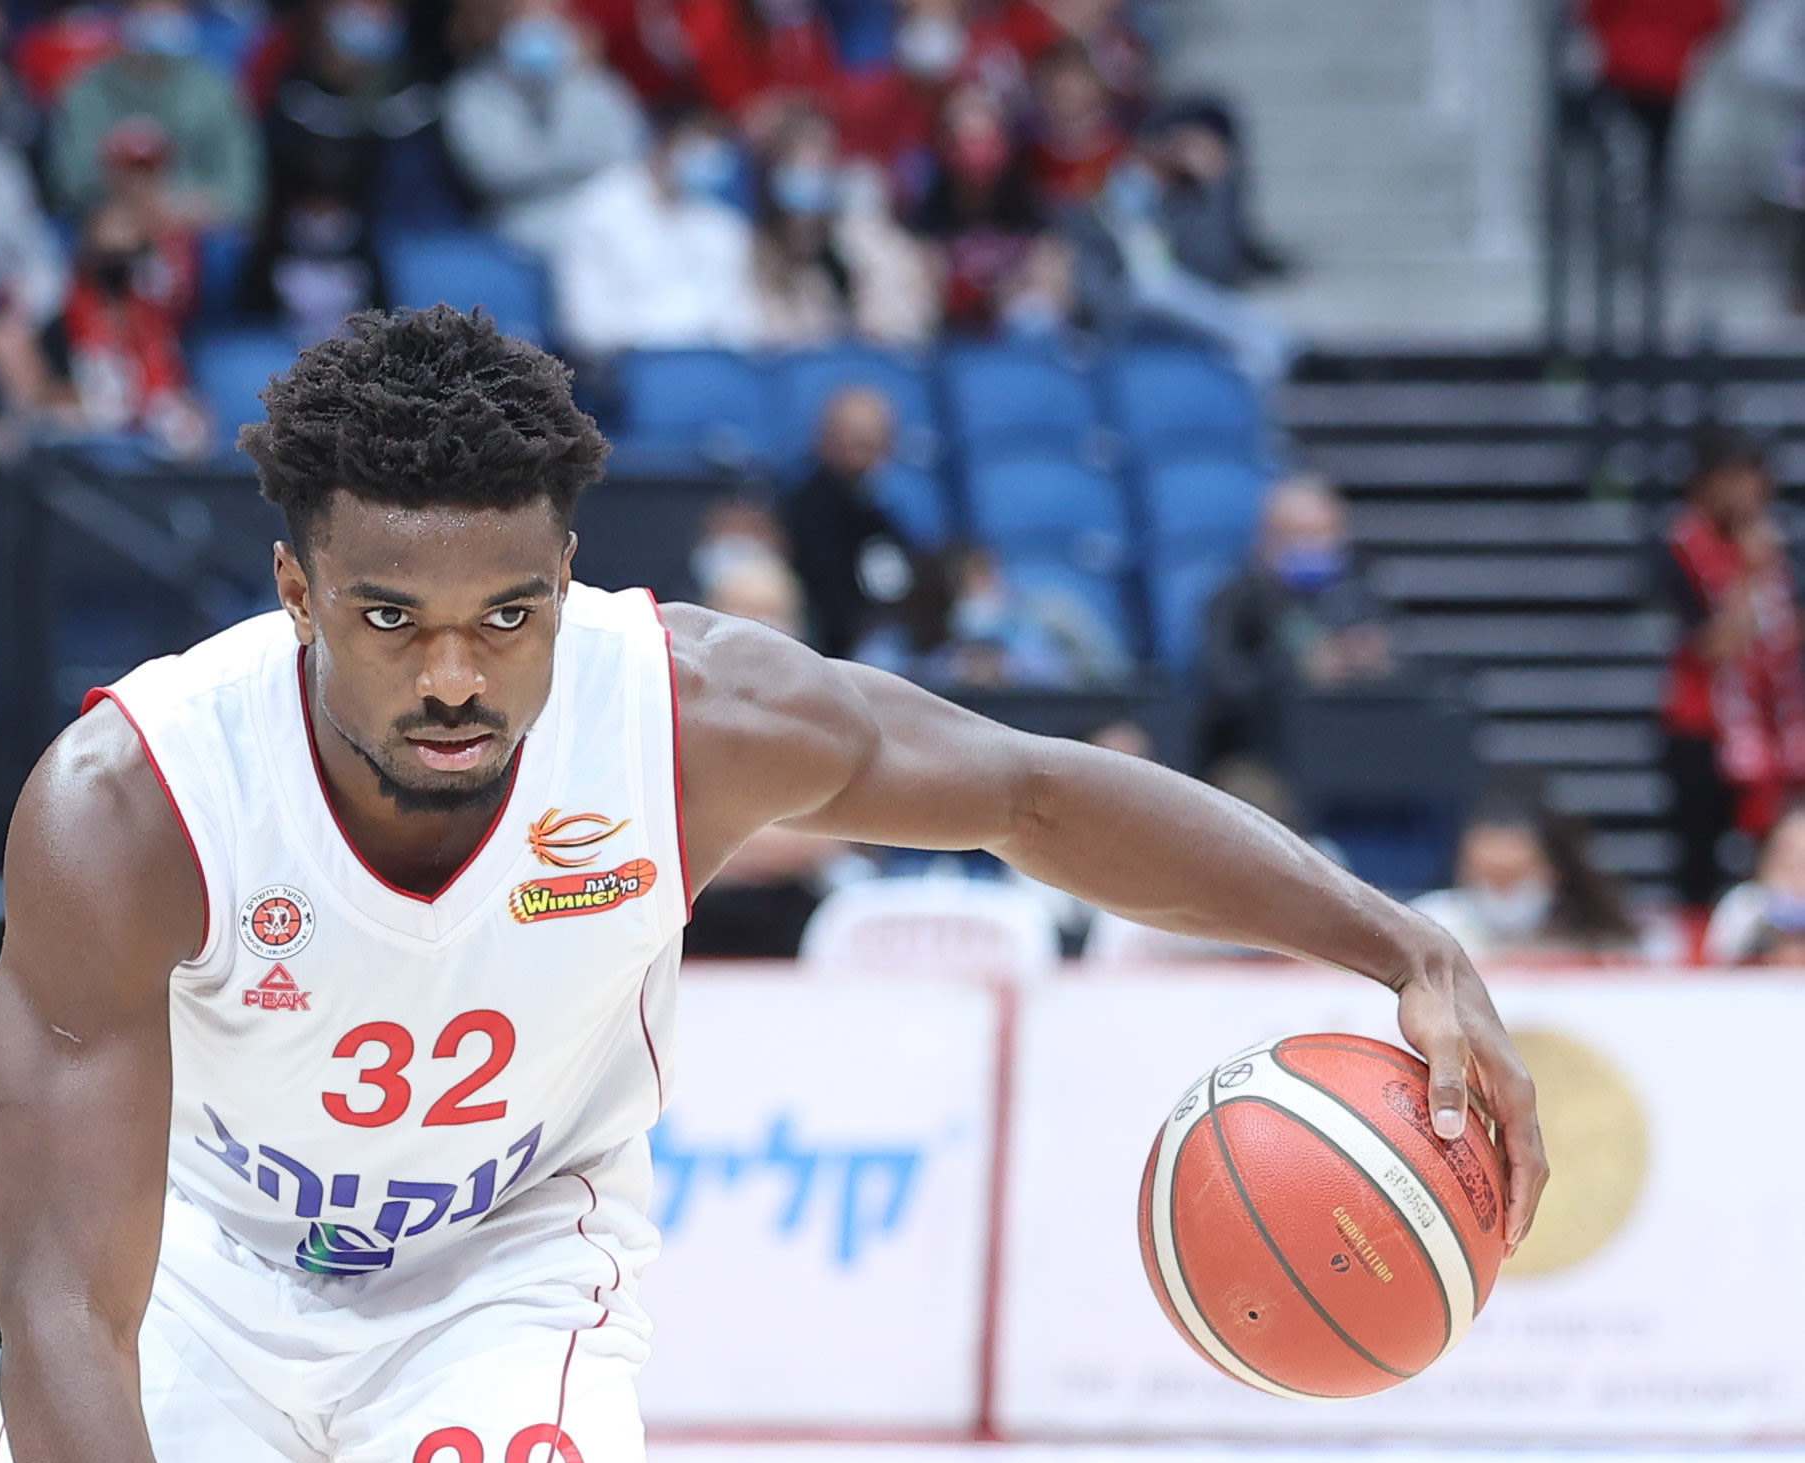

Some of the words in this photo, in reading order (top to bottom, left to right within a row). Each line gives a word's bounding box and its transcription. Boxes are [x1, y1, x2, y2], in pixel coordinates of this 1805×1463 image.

[242, 990, 312, 1011] PEAK
[321, 1008, 516, 1129] 32
[1332, 1206, 1394, 1284] COMPETITION
